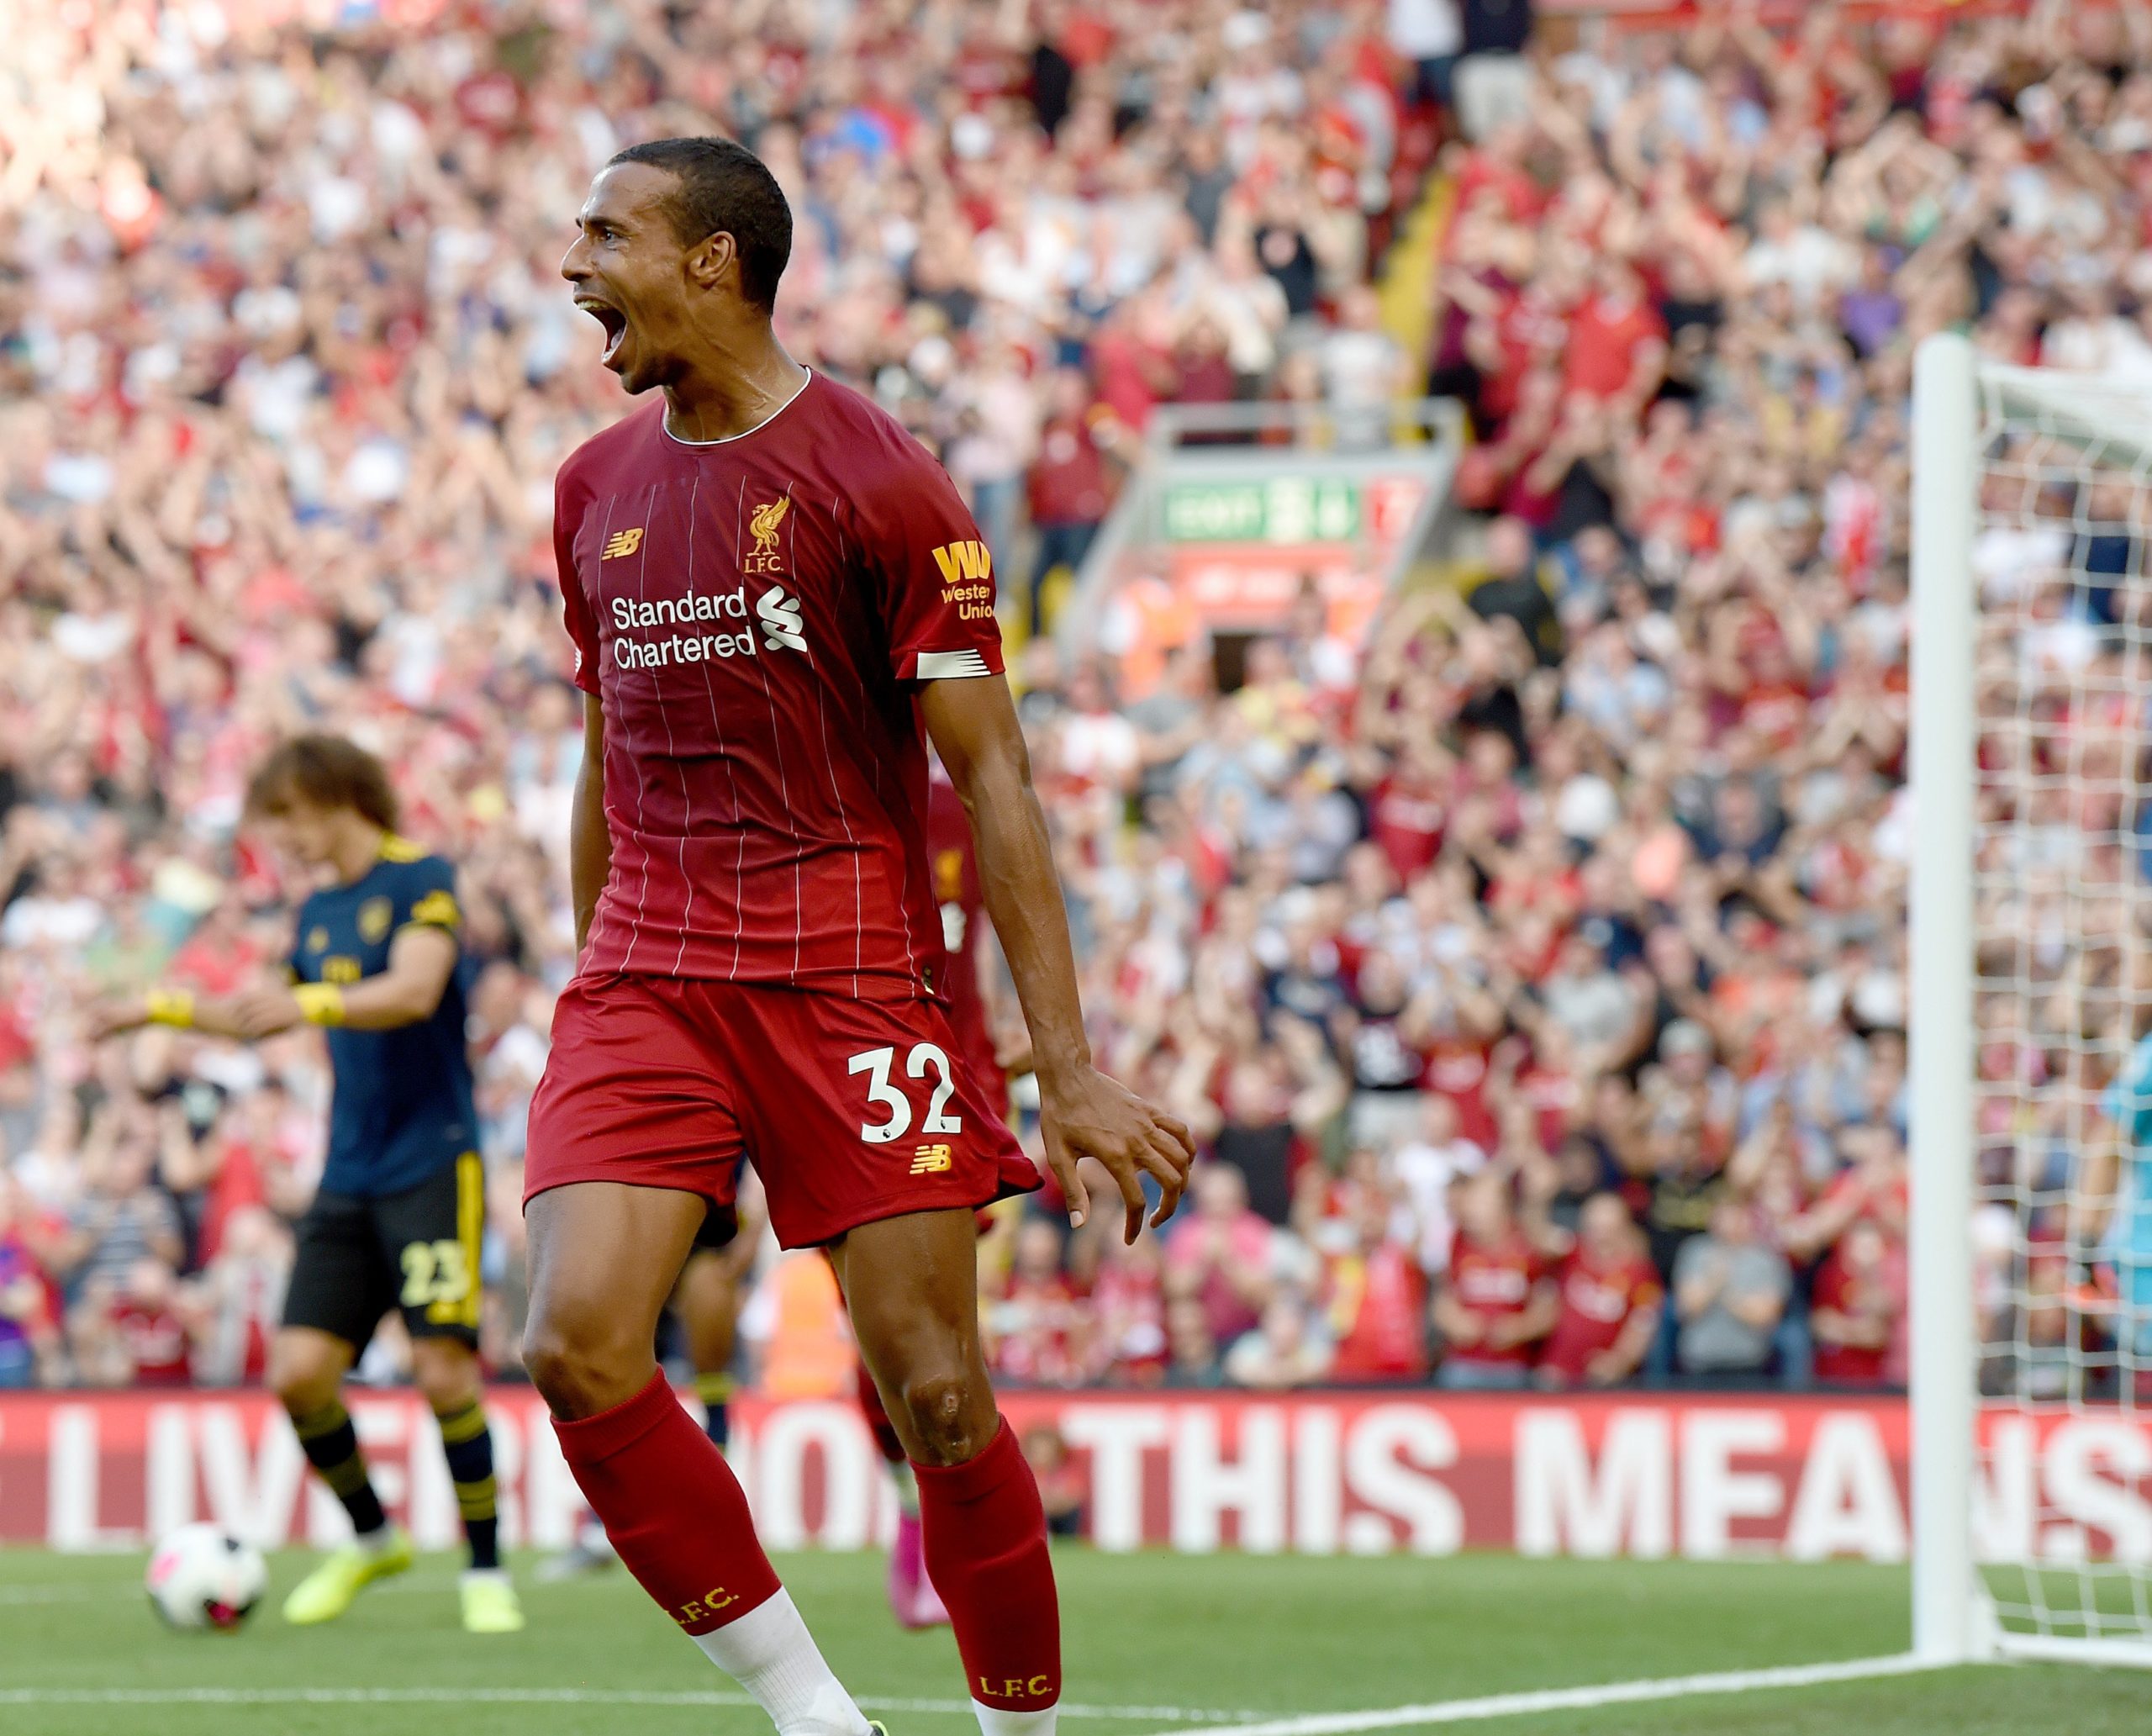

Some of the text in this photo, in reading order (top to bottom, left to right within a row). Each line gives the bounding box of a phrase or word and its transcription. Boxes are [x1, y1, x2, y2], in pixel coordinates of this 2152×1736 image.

[611, 586, 747, 631] Standard
[959, 599, 995, 620] Unio
[614, 625, 757, 669] Chartered
[848, 1042, 961, 1143] 32
[400, 1239, 471, 1307] 23
[1058, 1402, 1464, 1559] THIS
[978, 1674, 1053, 1698] L.F.C.
